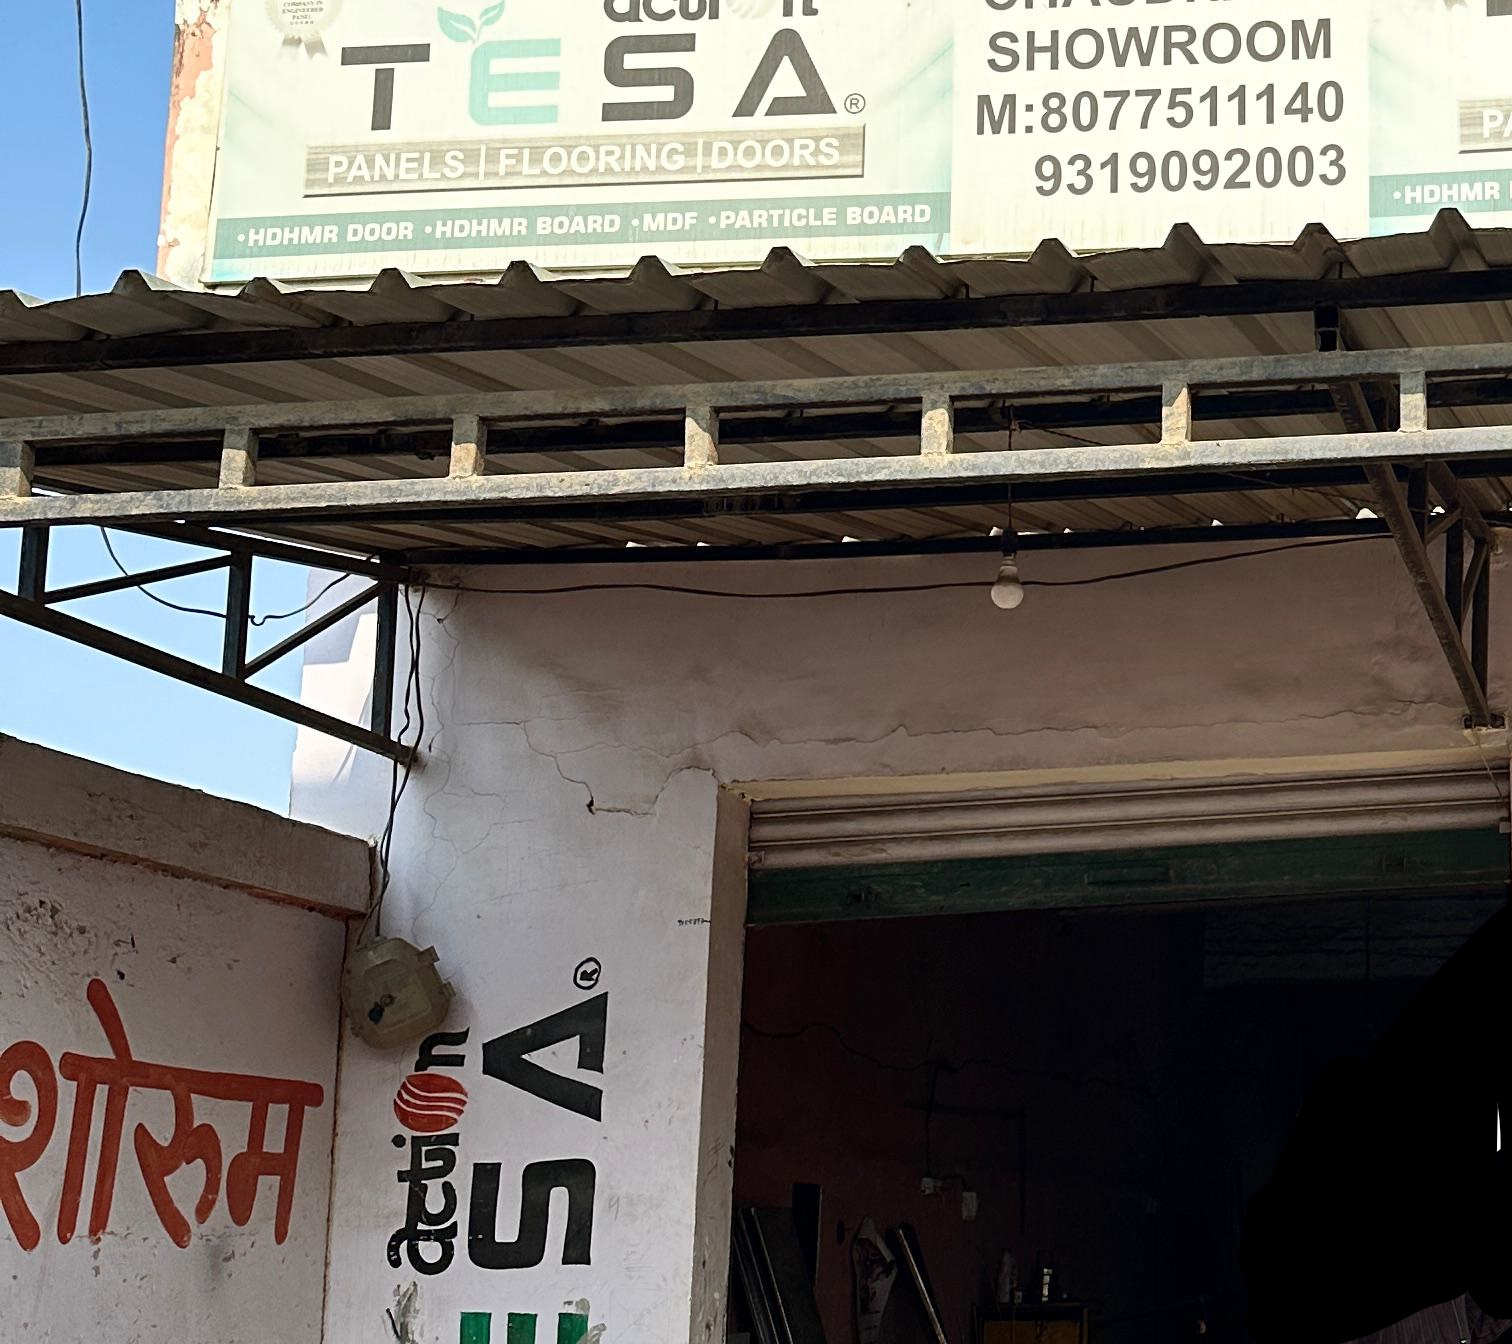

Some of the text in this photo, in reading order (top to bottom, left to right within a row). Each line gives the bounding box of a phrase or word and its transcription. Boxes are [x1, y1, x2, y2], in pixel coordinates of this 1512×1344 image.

[986, 18, 1332, 73] SHOWROOM
[976, 80, 1344, 136] M:8077511140
[326, 137, 841, 184] PANELS FLOORING DOORS
[1034, 144, 1347, 197] 9319092003
[1403, 181, 1501, 206] HDHMR
[247, 202, 931, 248] HDHMR DOOR HDHMR BOARD MDF PARTICLE BOARD
